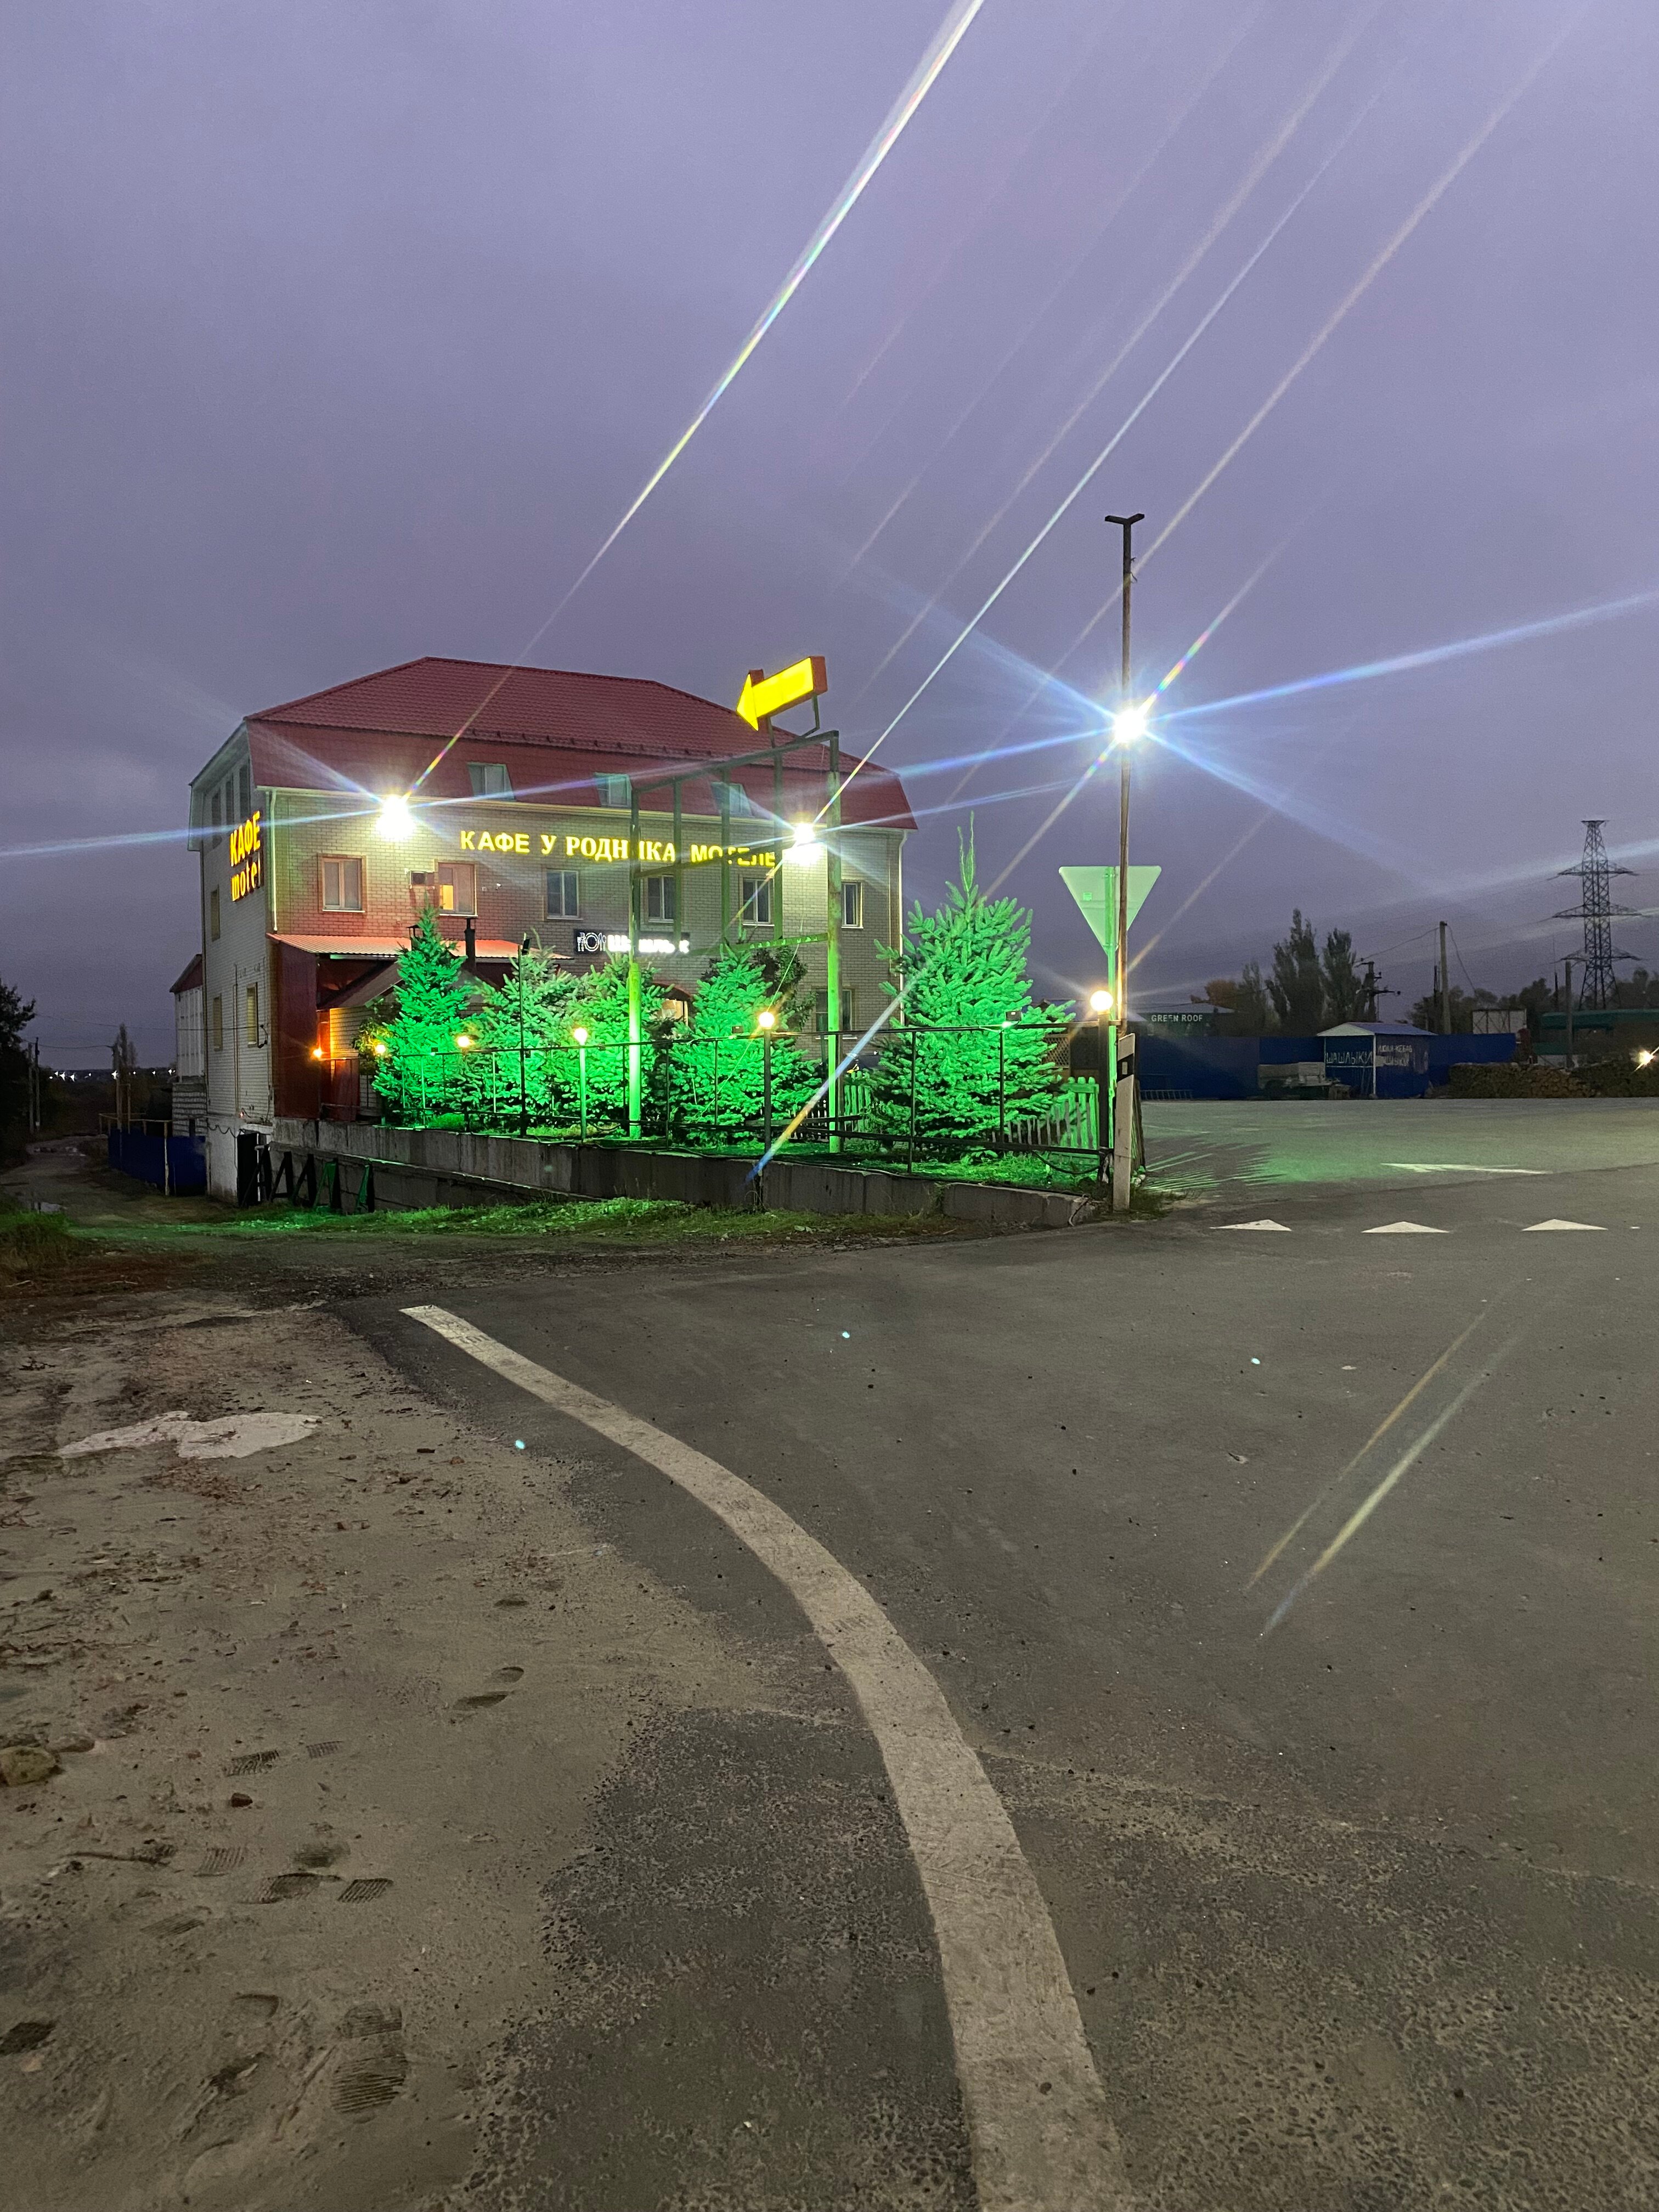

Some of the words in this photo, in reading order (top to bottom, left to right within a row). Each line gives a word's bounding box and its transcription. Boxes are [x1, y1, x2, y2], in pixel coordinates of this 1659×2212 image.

[229, 810, 261, 867] КАФЕ
[460, 830, 531, 854] КАФЕ
[540, 833, 557, 855] У
[1151, 1014, 1179, 1022] GREEN
[1181, 1014, 1203, 1022] ROOF
[1326, 1051, 1373, 1065] ШАШЛЫКИ
